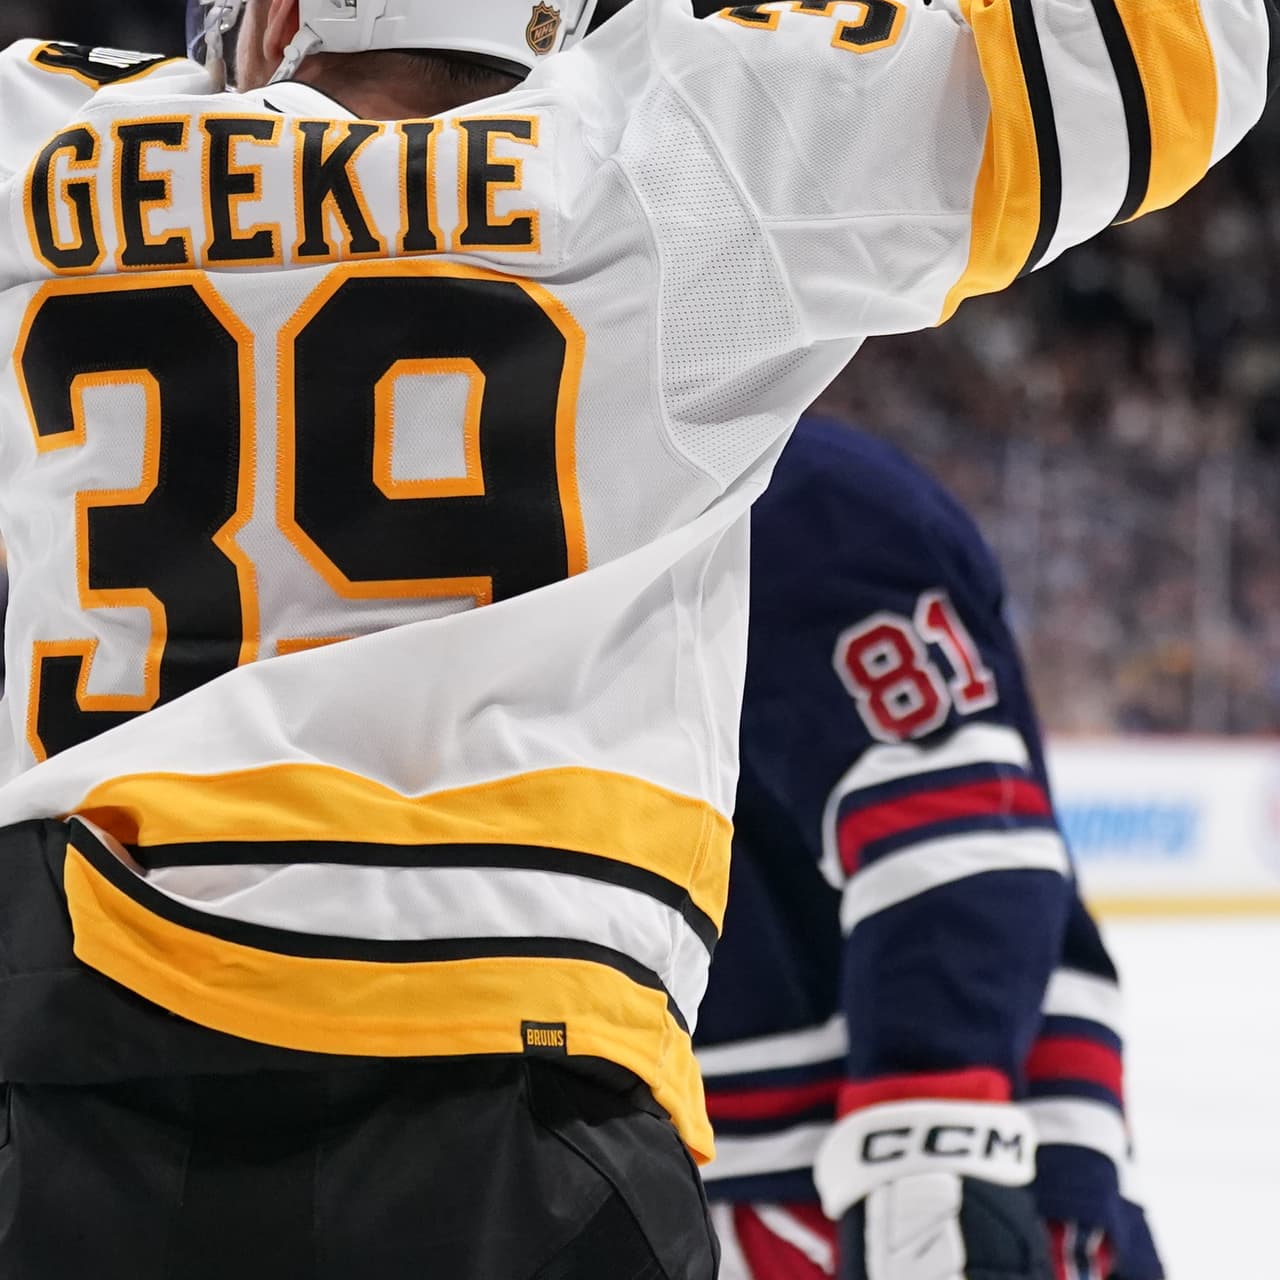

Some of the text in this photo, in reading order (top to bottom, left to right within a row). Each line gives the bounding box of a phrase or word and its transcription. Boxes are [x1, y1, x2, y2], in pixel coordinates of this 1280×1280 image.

[23, 113, 542, 275] GEEKIE
[12, 261, 588, 762] 39
[833, 588, 998, 743] 81
[526, 1028, 565, 1047] BRUINS
[861, 1125, 1024, 1163] CCM
